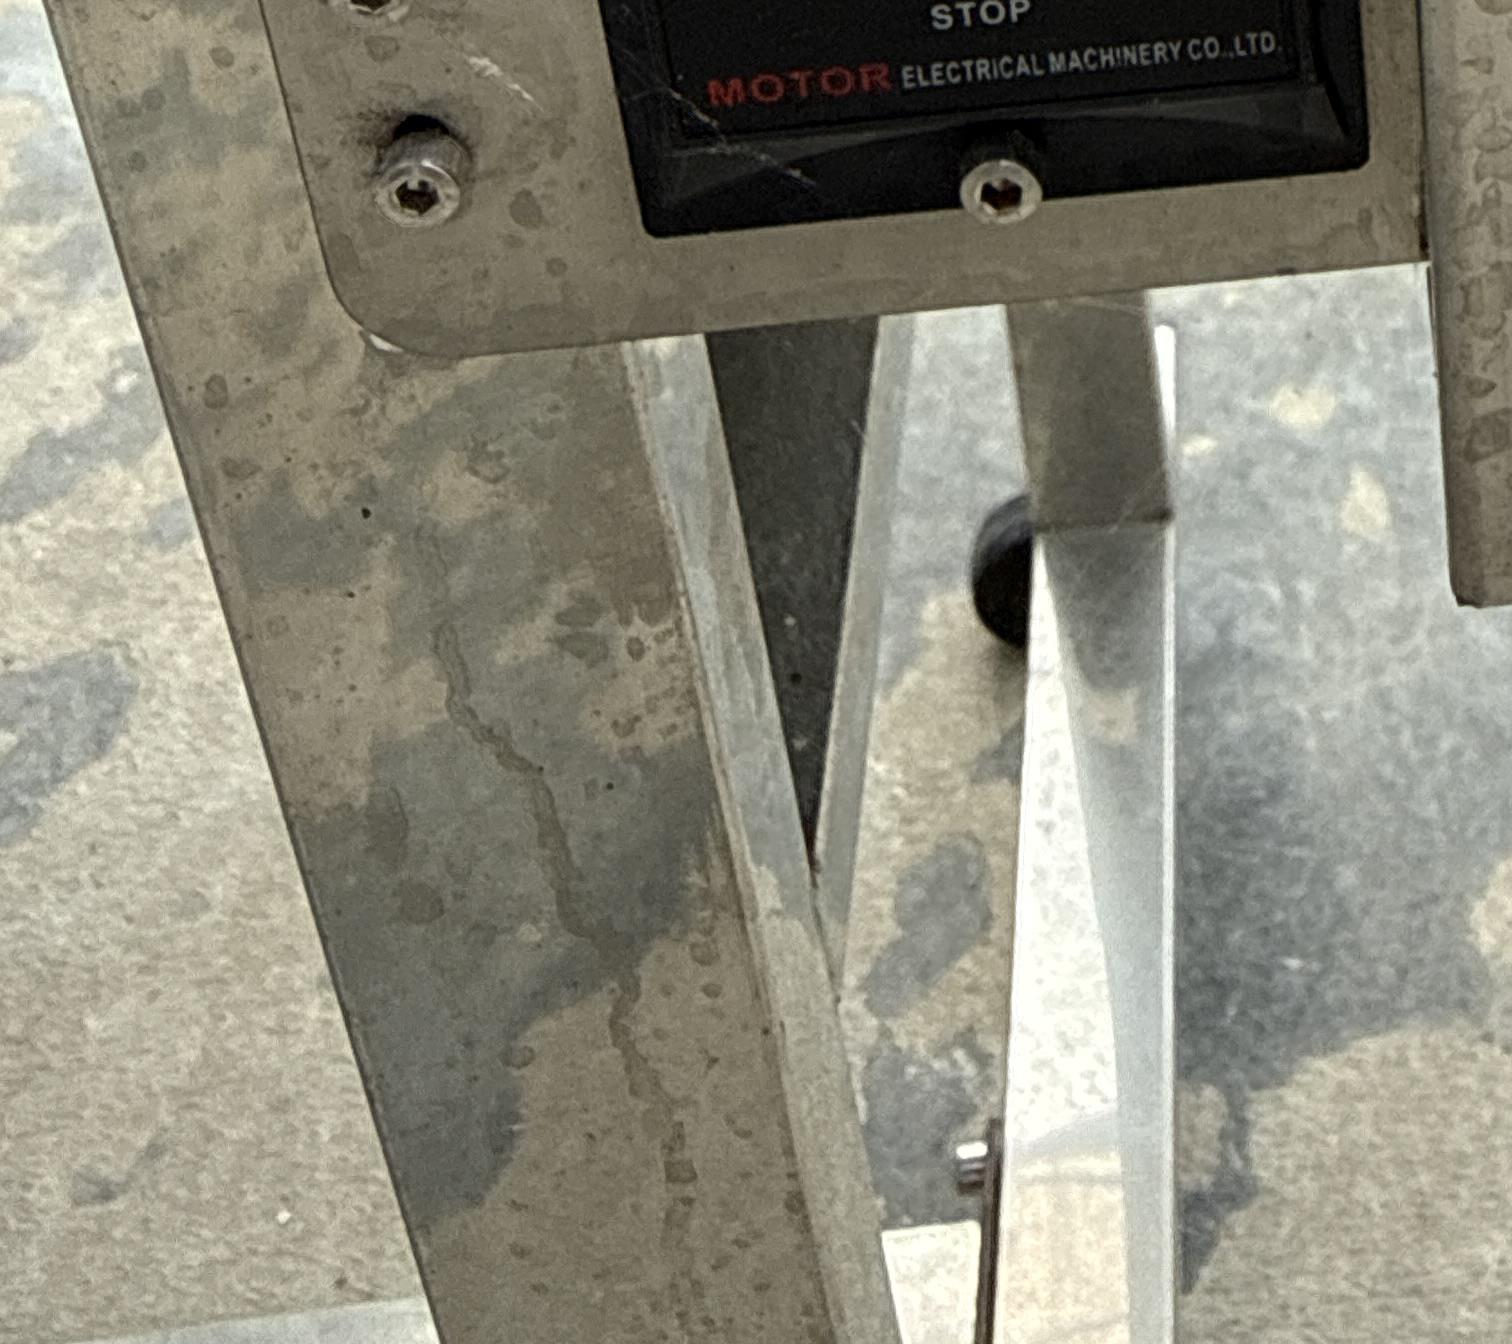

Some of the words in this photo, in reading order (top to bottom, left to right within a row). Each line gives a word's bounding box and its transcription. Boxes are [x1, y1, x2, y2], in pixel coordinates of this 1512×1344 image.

[708, 64, 890, 106] MOTOR
[902, 54, 1044, 88] ELECTRICAL
[1048, 41, 1181, 73] MACHINERY
